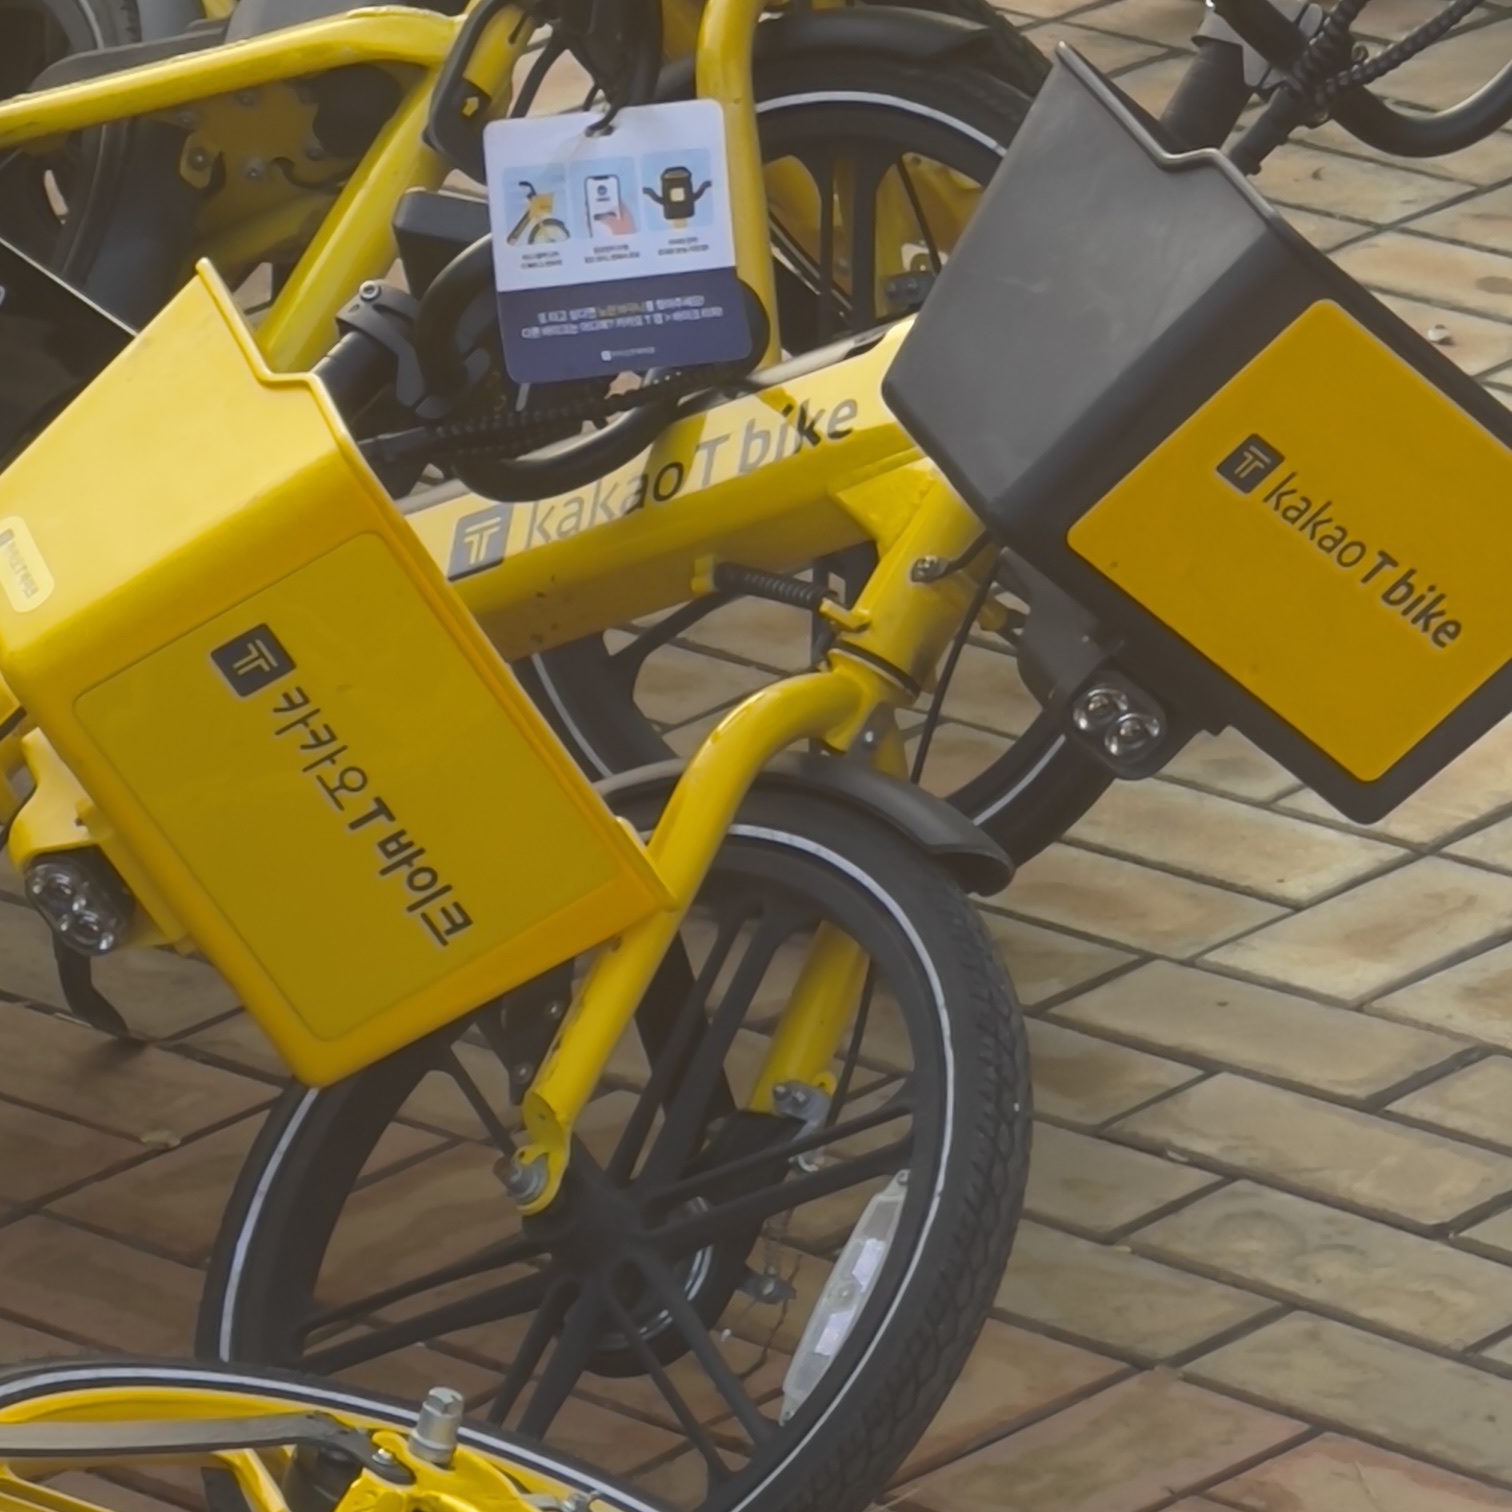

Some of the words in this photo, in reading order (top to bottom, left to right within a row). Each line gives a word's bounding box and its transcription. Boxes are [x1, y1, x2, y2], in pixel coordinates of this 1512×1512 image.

[524, 461, 685, 551] kakao
[695, 433, 731, 488] T
[737, 398, 859, 476] bike
[1262, 471, 1367, 568] kakao
[1359, 550, 1399, 584] T
[1380, 567, 1463, 649] bike
